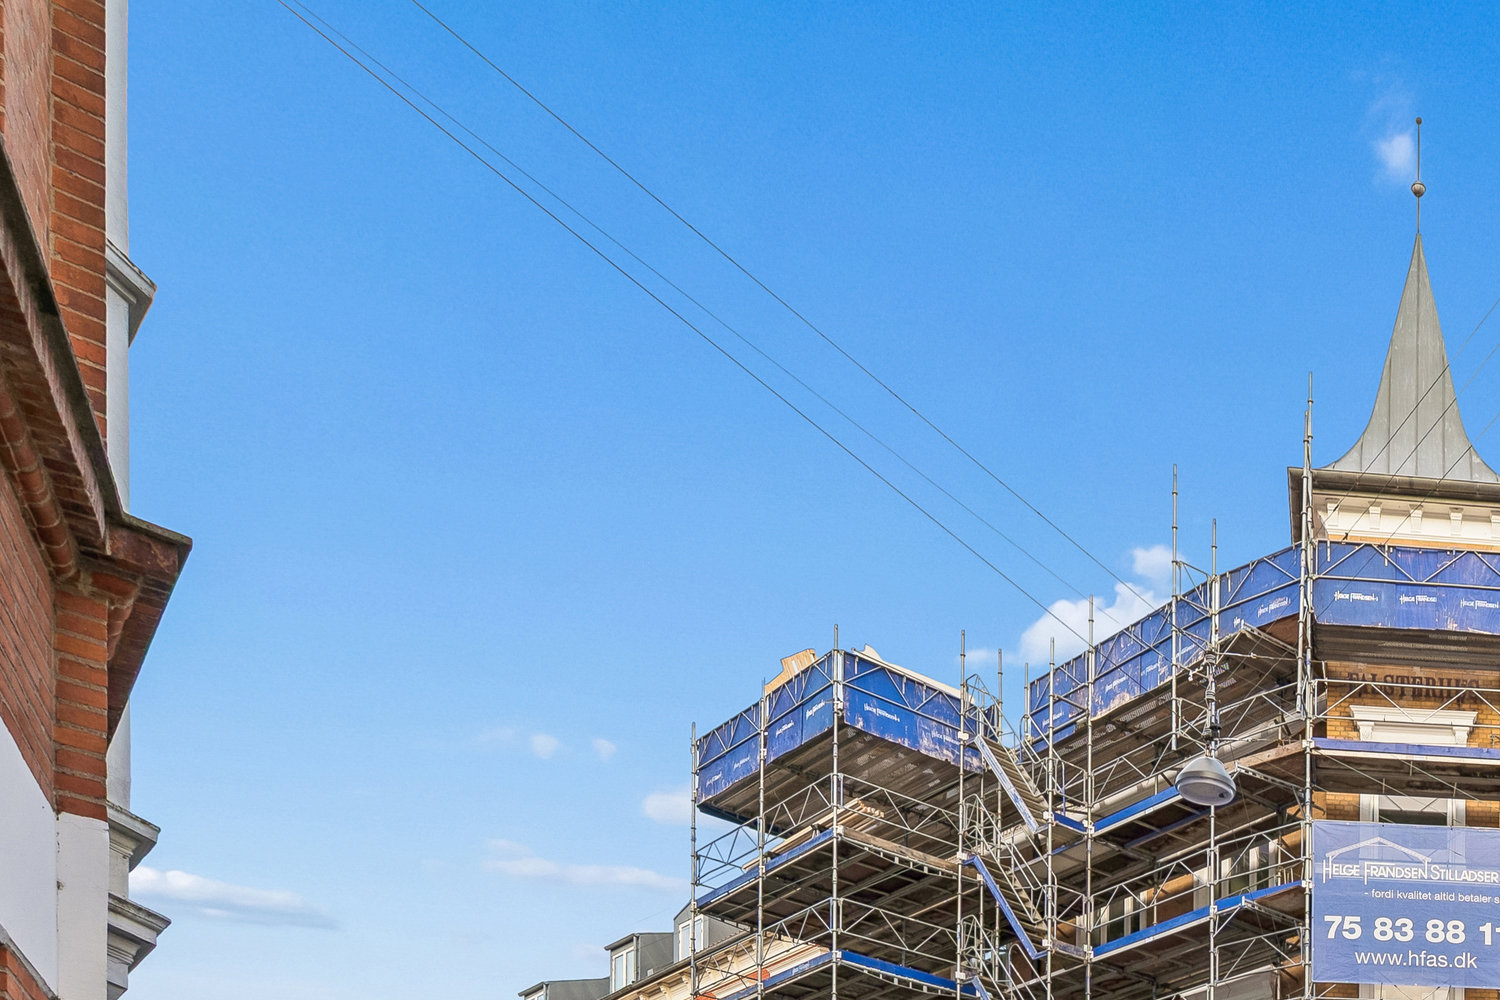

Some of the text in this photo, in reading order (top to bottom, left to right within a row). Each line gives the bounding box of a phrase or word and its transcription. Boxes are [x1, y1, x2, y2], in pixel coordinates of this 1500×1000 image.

[1323, 857, 1360, 884] HELGE
[1364, 861, 1428, 885] FRANDSEN
[1372, 889, 1394, 899] fordi
[1397, 890, 1431, 900] kvalitet
[1435, 892, 1455, 902] altid
[1458, 893, 1491, 903] betaler
[1324, 915, 1362, 939] 75
[1373, 917, 1414, 942] 83
[1425, 919, 1465, 944] 88
[1354, 951, 1478, 969] www.hfas.dk
